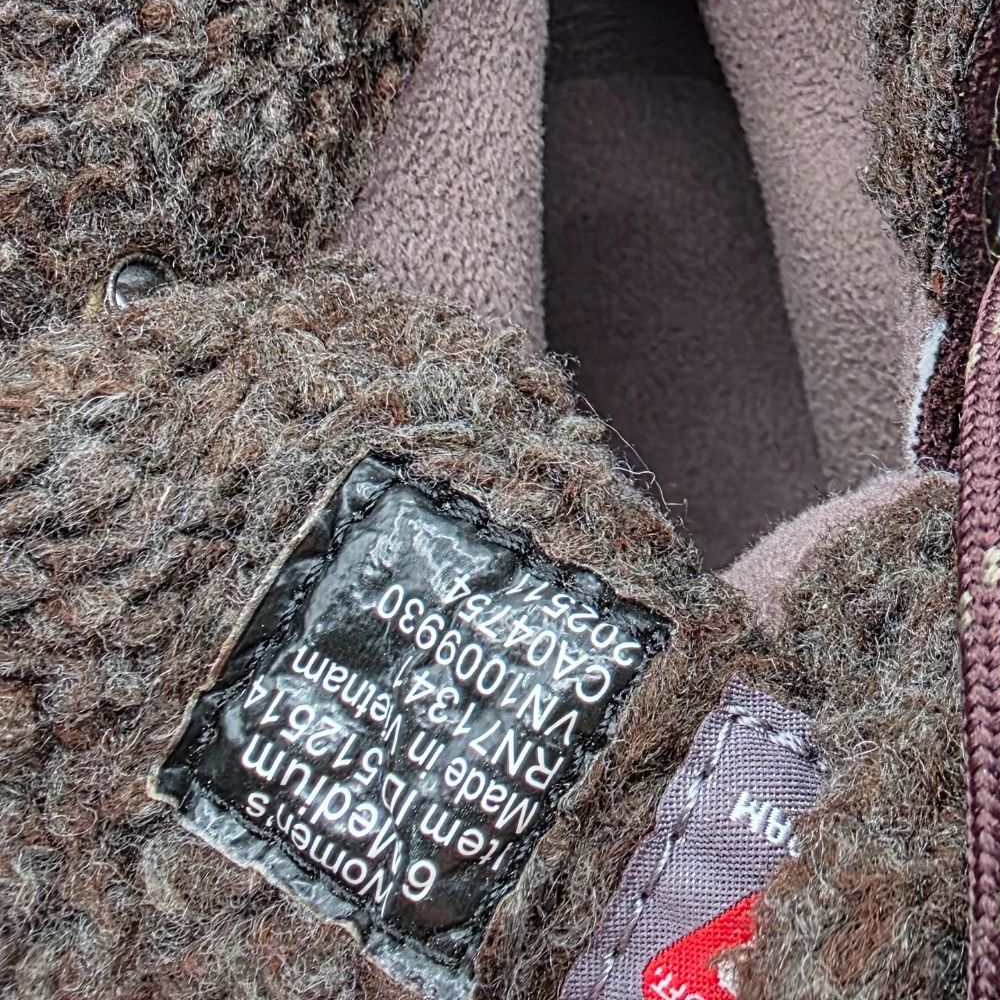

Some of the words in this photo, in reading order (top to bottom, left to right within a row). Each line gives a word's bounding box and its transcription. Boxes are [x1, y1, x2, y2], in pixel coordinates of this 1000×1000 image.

[376, 585, 578, 745] VN1009930
[442, 573, 610, 702] CA04754
[508, 574, 641, 666] 202511
[243, 676, 384, 786] 512514
[292, 646, 402, 752] Vietnam
[391, 657, 564, 789] RN71341
[242, 734, 400, 873] Medium
[382, 774, 413, 826] ID
[408, 731, 445, 779] in
[434, 757, 538, 833] Made
[245, 793, 394, 905] Women's
[402, 859, 437, 902] 6
[420, 806, 511, 870] Item
